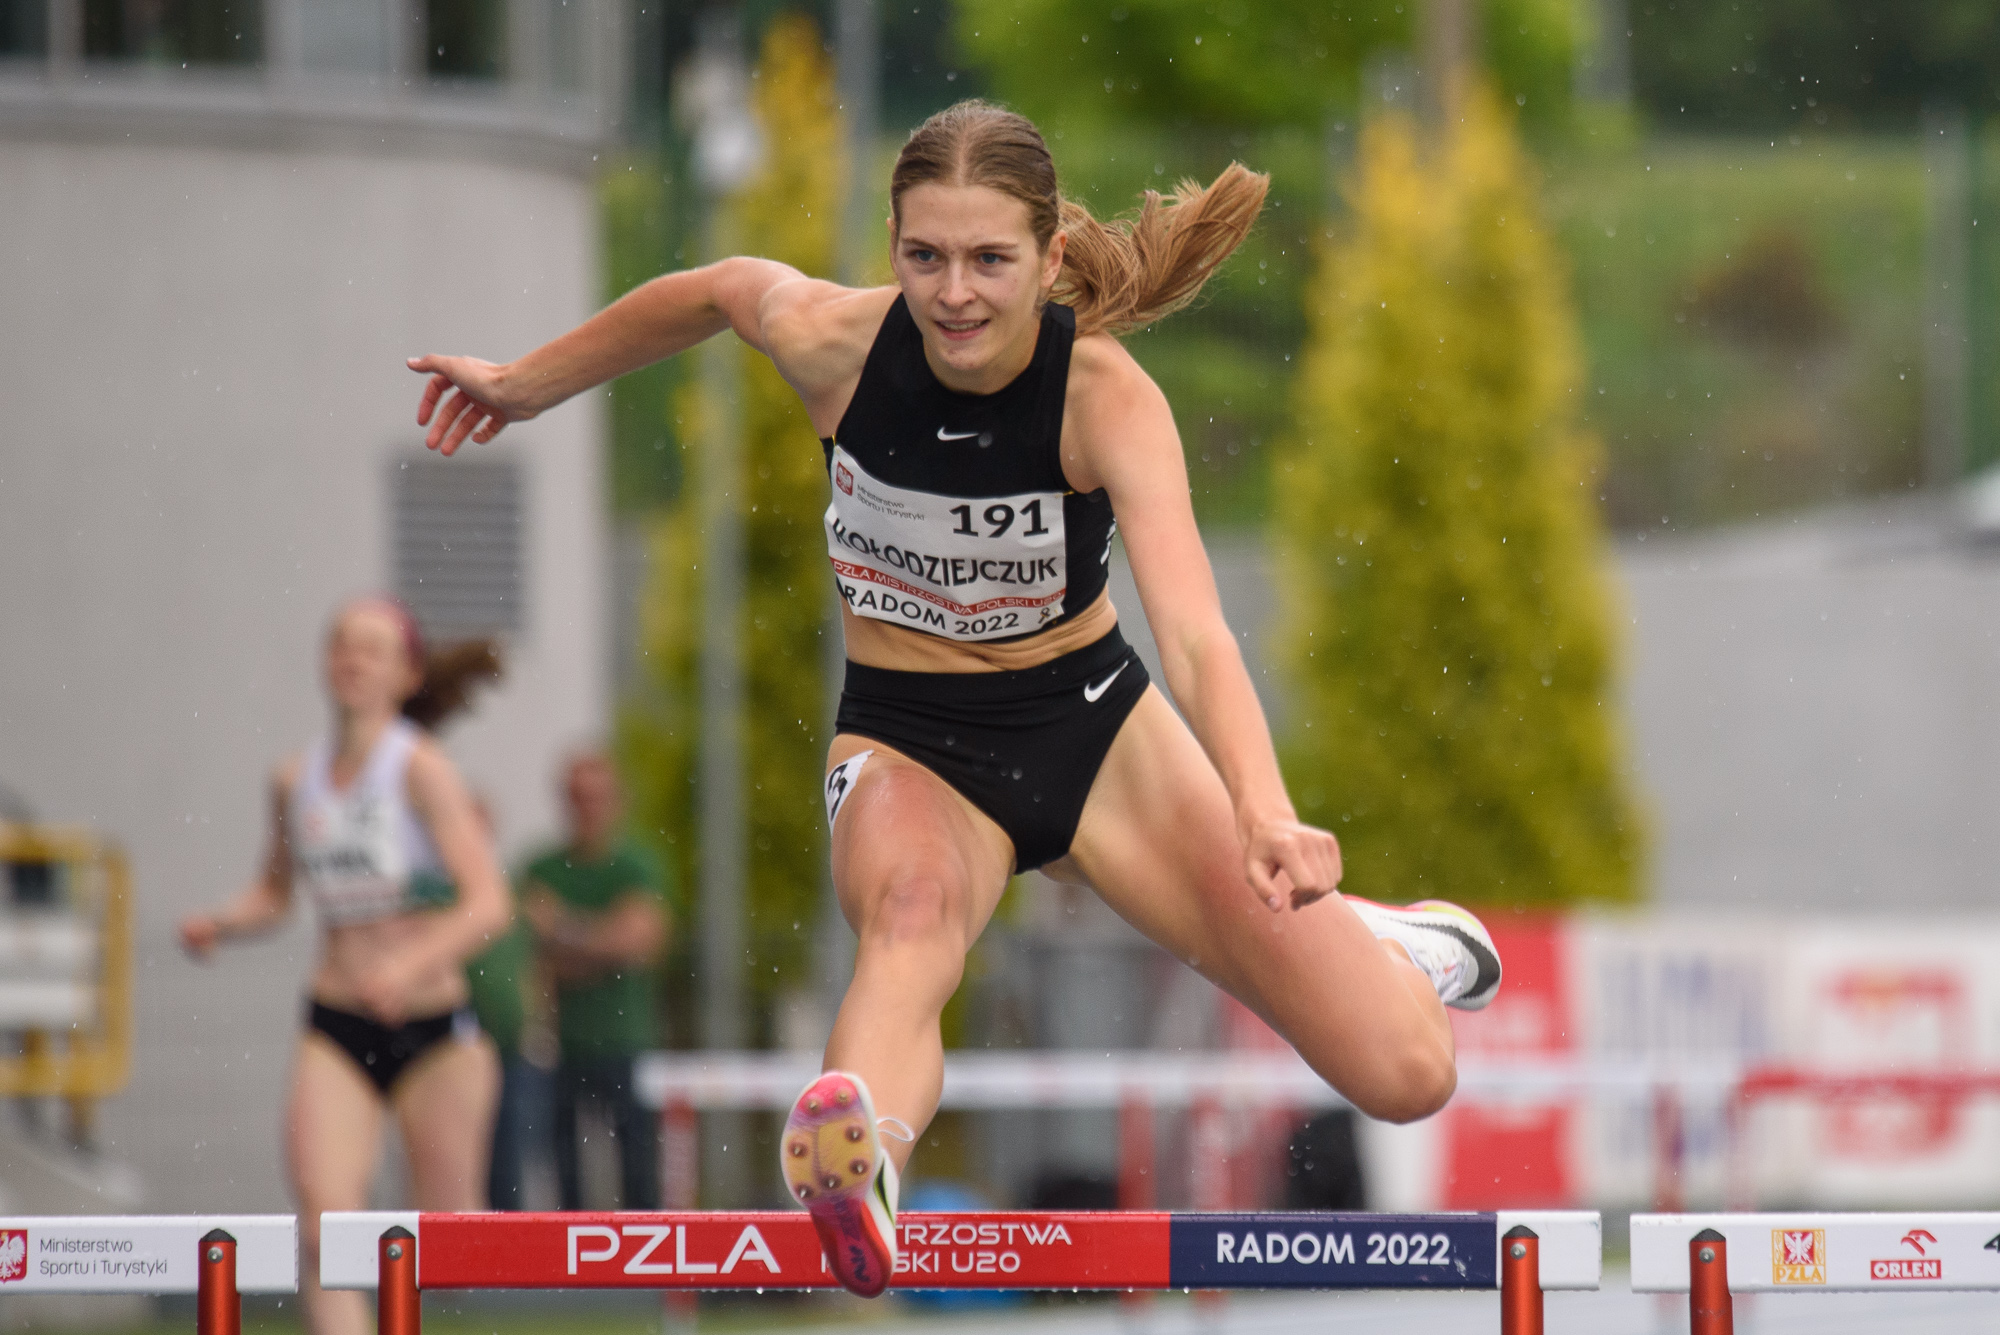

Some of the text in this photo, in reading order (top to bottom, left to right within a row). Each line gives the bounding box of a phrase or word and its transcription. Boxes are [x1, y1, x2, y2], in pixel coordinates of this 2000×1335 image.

[857, 485, 904, 508] Ministerstwo
[857, 493, 881, 512] Sportu
[886, 507, 925, 520] Turystyki
[949, 499, 1049, 538] 191
[833, 517, 1058, 587] KOŁODZIEJCZUK
[833, 561, 871, 580] PZLA
[874, 573, 973, 615] MISTRZOSTWA
[976, 598, 1028, 612] POLSKI
[844, 585, 1020, 635] RADOM 2022
[40, 1238, 133, 1253] Ministerstwo
[896, 1224, 1072, 1246] RZOSTWA
[567, 1225, 782, 1275] PZLA
[1216, 1233, 1450, 1265] RADOM 2022
[40, 1260, 167, 1277] Sportu i Turystyki
[951, 1252, 1021, 1273] U20
[1775, 1266, 1823, 1282] PZLA
[1873, 1262, 1938, 1279] ORLEN
